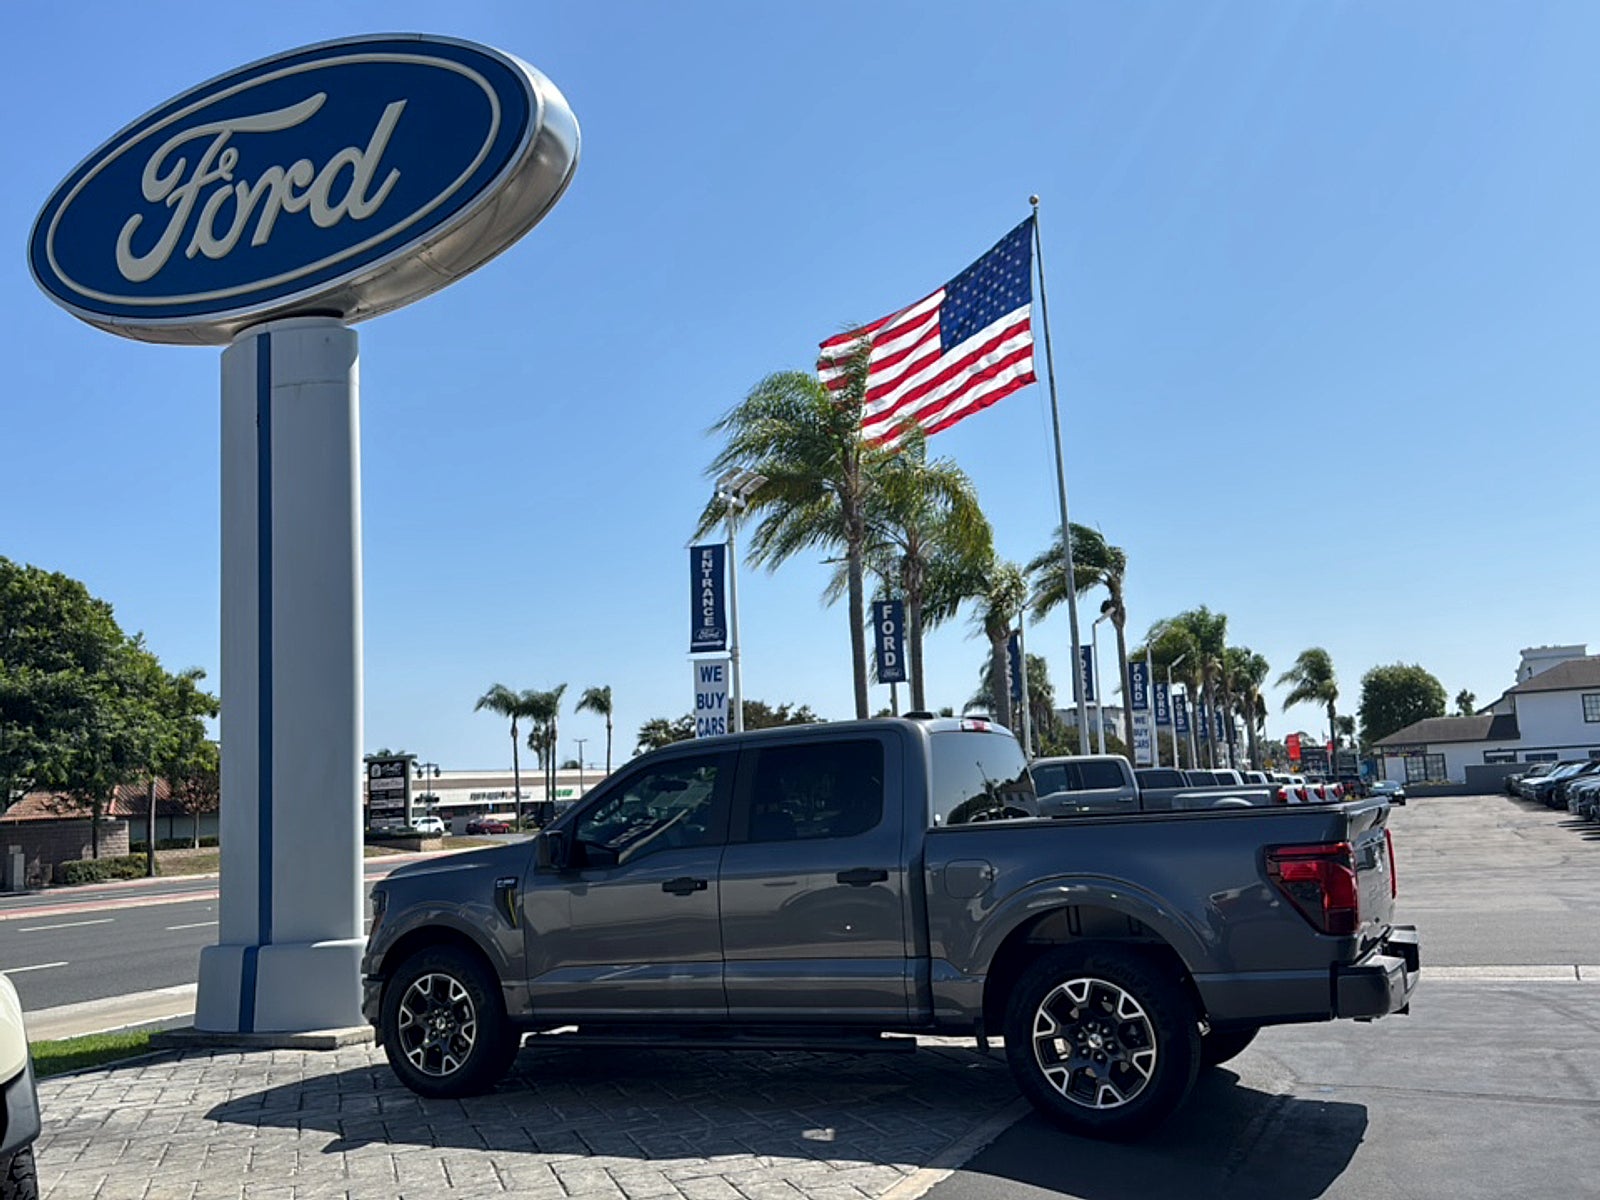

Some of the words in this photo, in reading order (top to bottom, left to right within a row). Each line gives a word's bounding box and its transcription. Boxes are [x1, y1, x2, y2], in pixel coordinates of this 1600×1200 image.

[116, 91, 408, 282] Ford
[701, 549, 715, 627] ENTRANCE
[881, 605, 897, 667] FORD
[700, 665, 723, 682] WE
[1133, 663, 1143, 701] FORD
[696, 692, 726, 709] BUY
[1156, 684, 1166, 716] FORD
[697, 716, 725, 737] CARS
